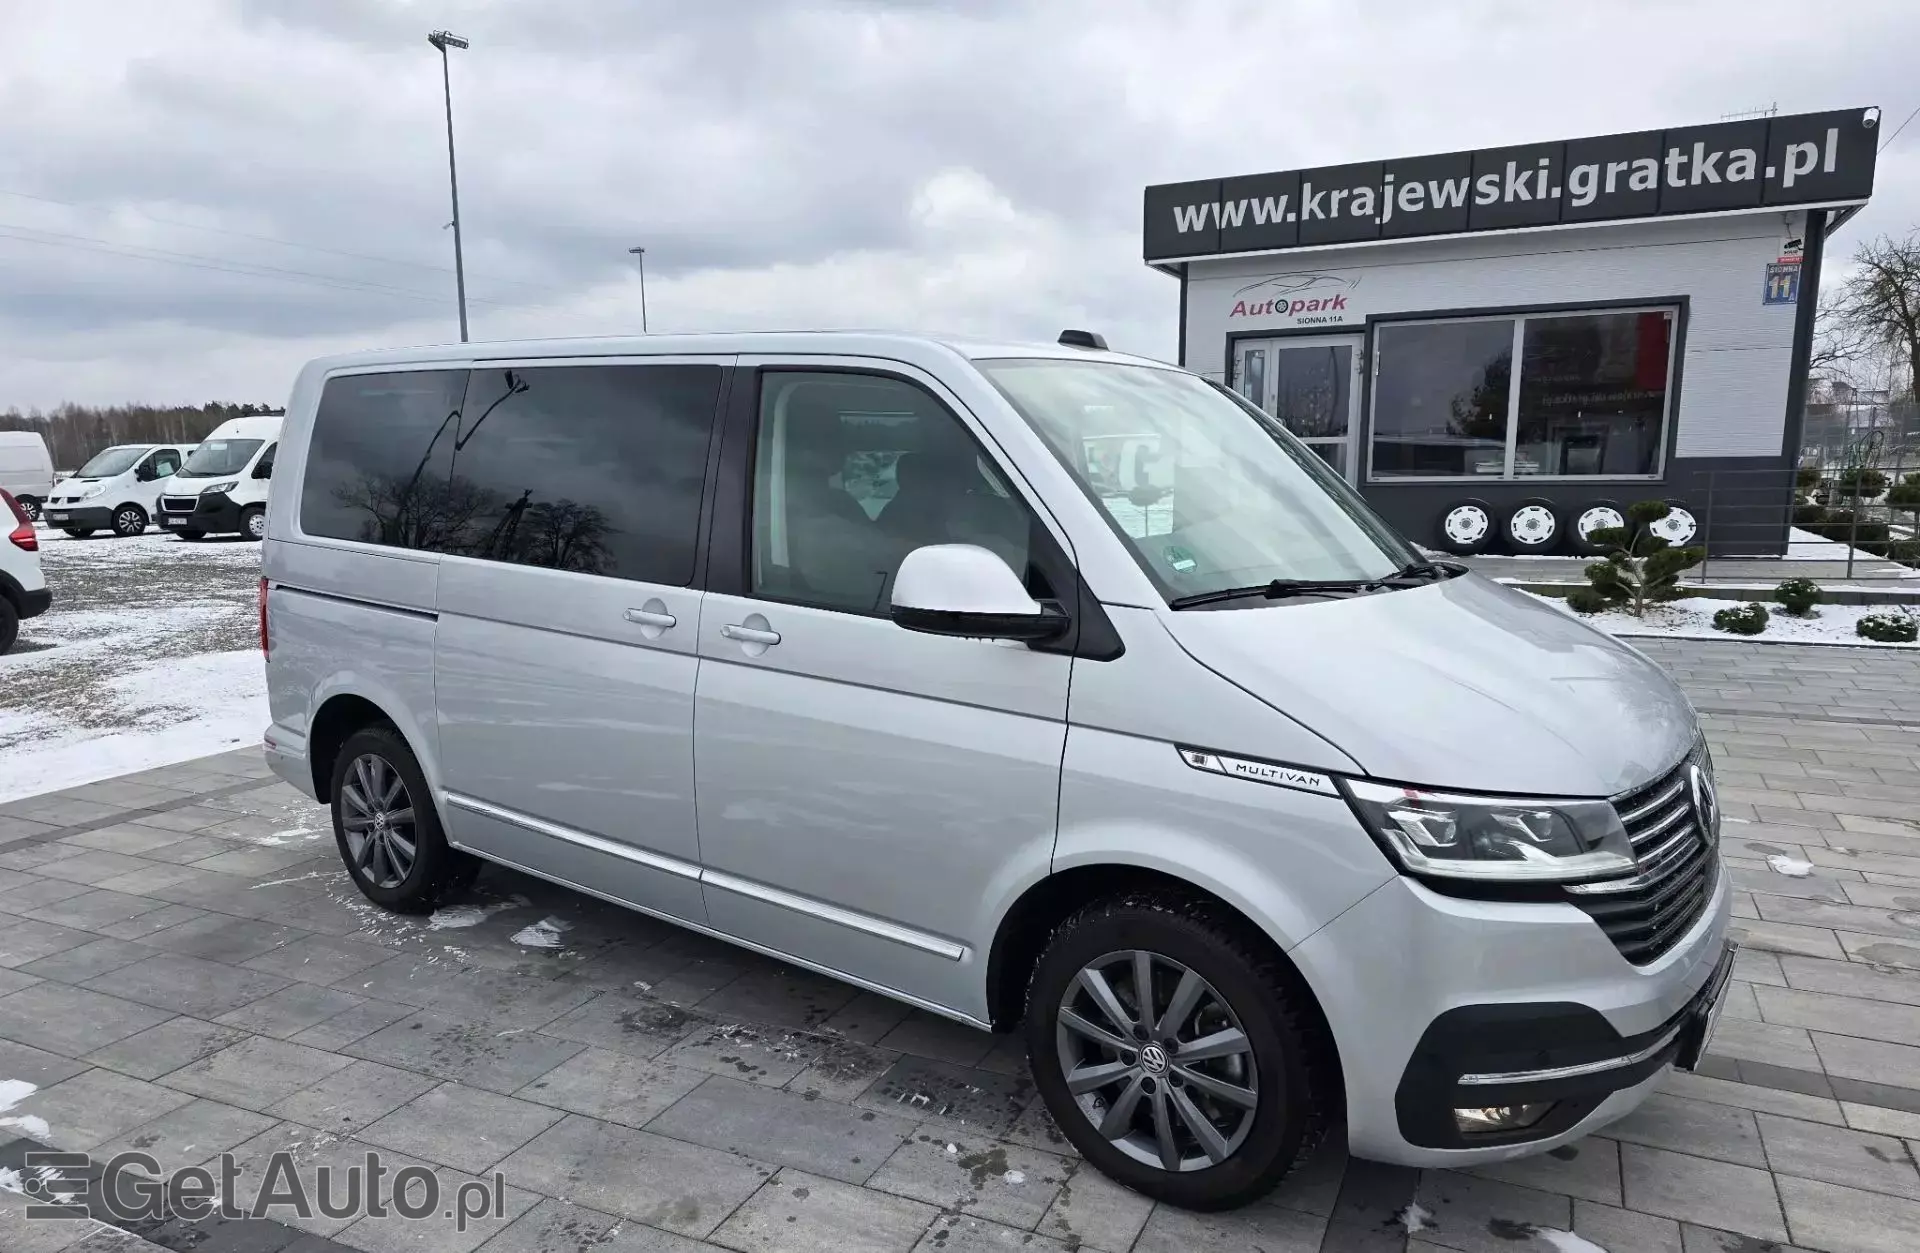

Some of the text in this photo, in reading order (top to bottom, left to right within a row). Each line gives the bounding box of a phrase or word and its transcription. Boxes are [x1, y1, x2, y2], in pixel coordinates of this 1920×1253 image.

[1173, 128, 1839, 234] www.krajewski.gratka.pl
[1230, 294, 1348, 317] Autopark
[1297, 317, 1327, 325] SIONNA
[1236, 763, 1320, 786] MULTIVAN
